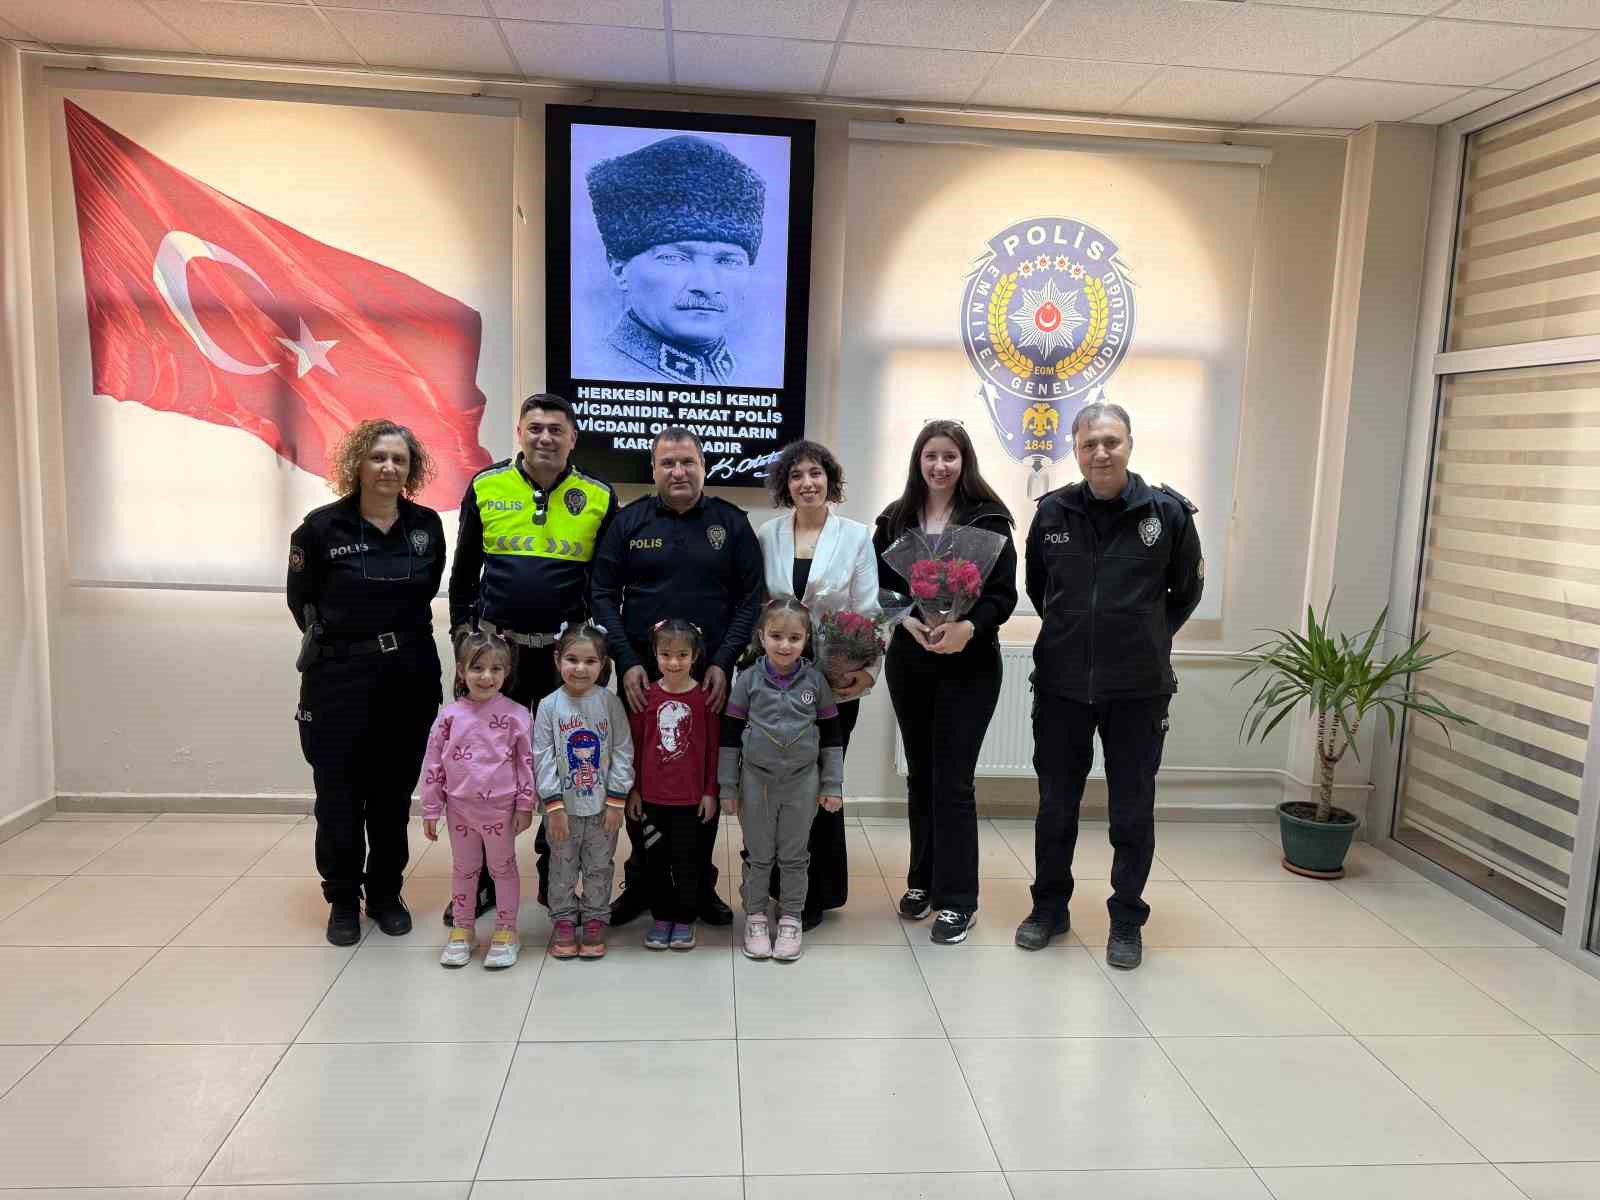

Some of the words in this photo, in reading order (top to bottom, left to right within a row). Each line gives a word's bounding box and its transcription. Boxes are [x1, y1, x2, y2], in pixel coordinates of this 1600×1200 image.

[1003, 224, 1105, 261] POLİS
[972, 266, 1000, 378] EMNİYET
[1011, 377, 1074, 395] GENEL
[577, 386, 663, 402] HERKESİN
[668, 390, 722, 405] POLİSİ
[726, 393, 777, 407] KENDİ
[678, 407, 730, 421] FAKAT
[735, 409, 783, 423] POLİS
[576, 417, 645, 434] VİCDANI
[649, 422, 777, 440] OAYANLARIN
[1024, 440, 1053, 451] 1845
